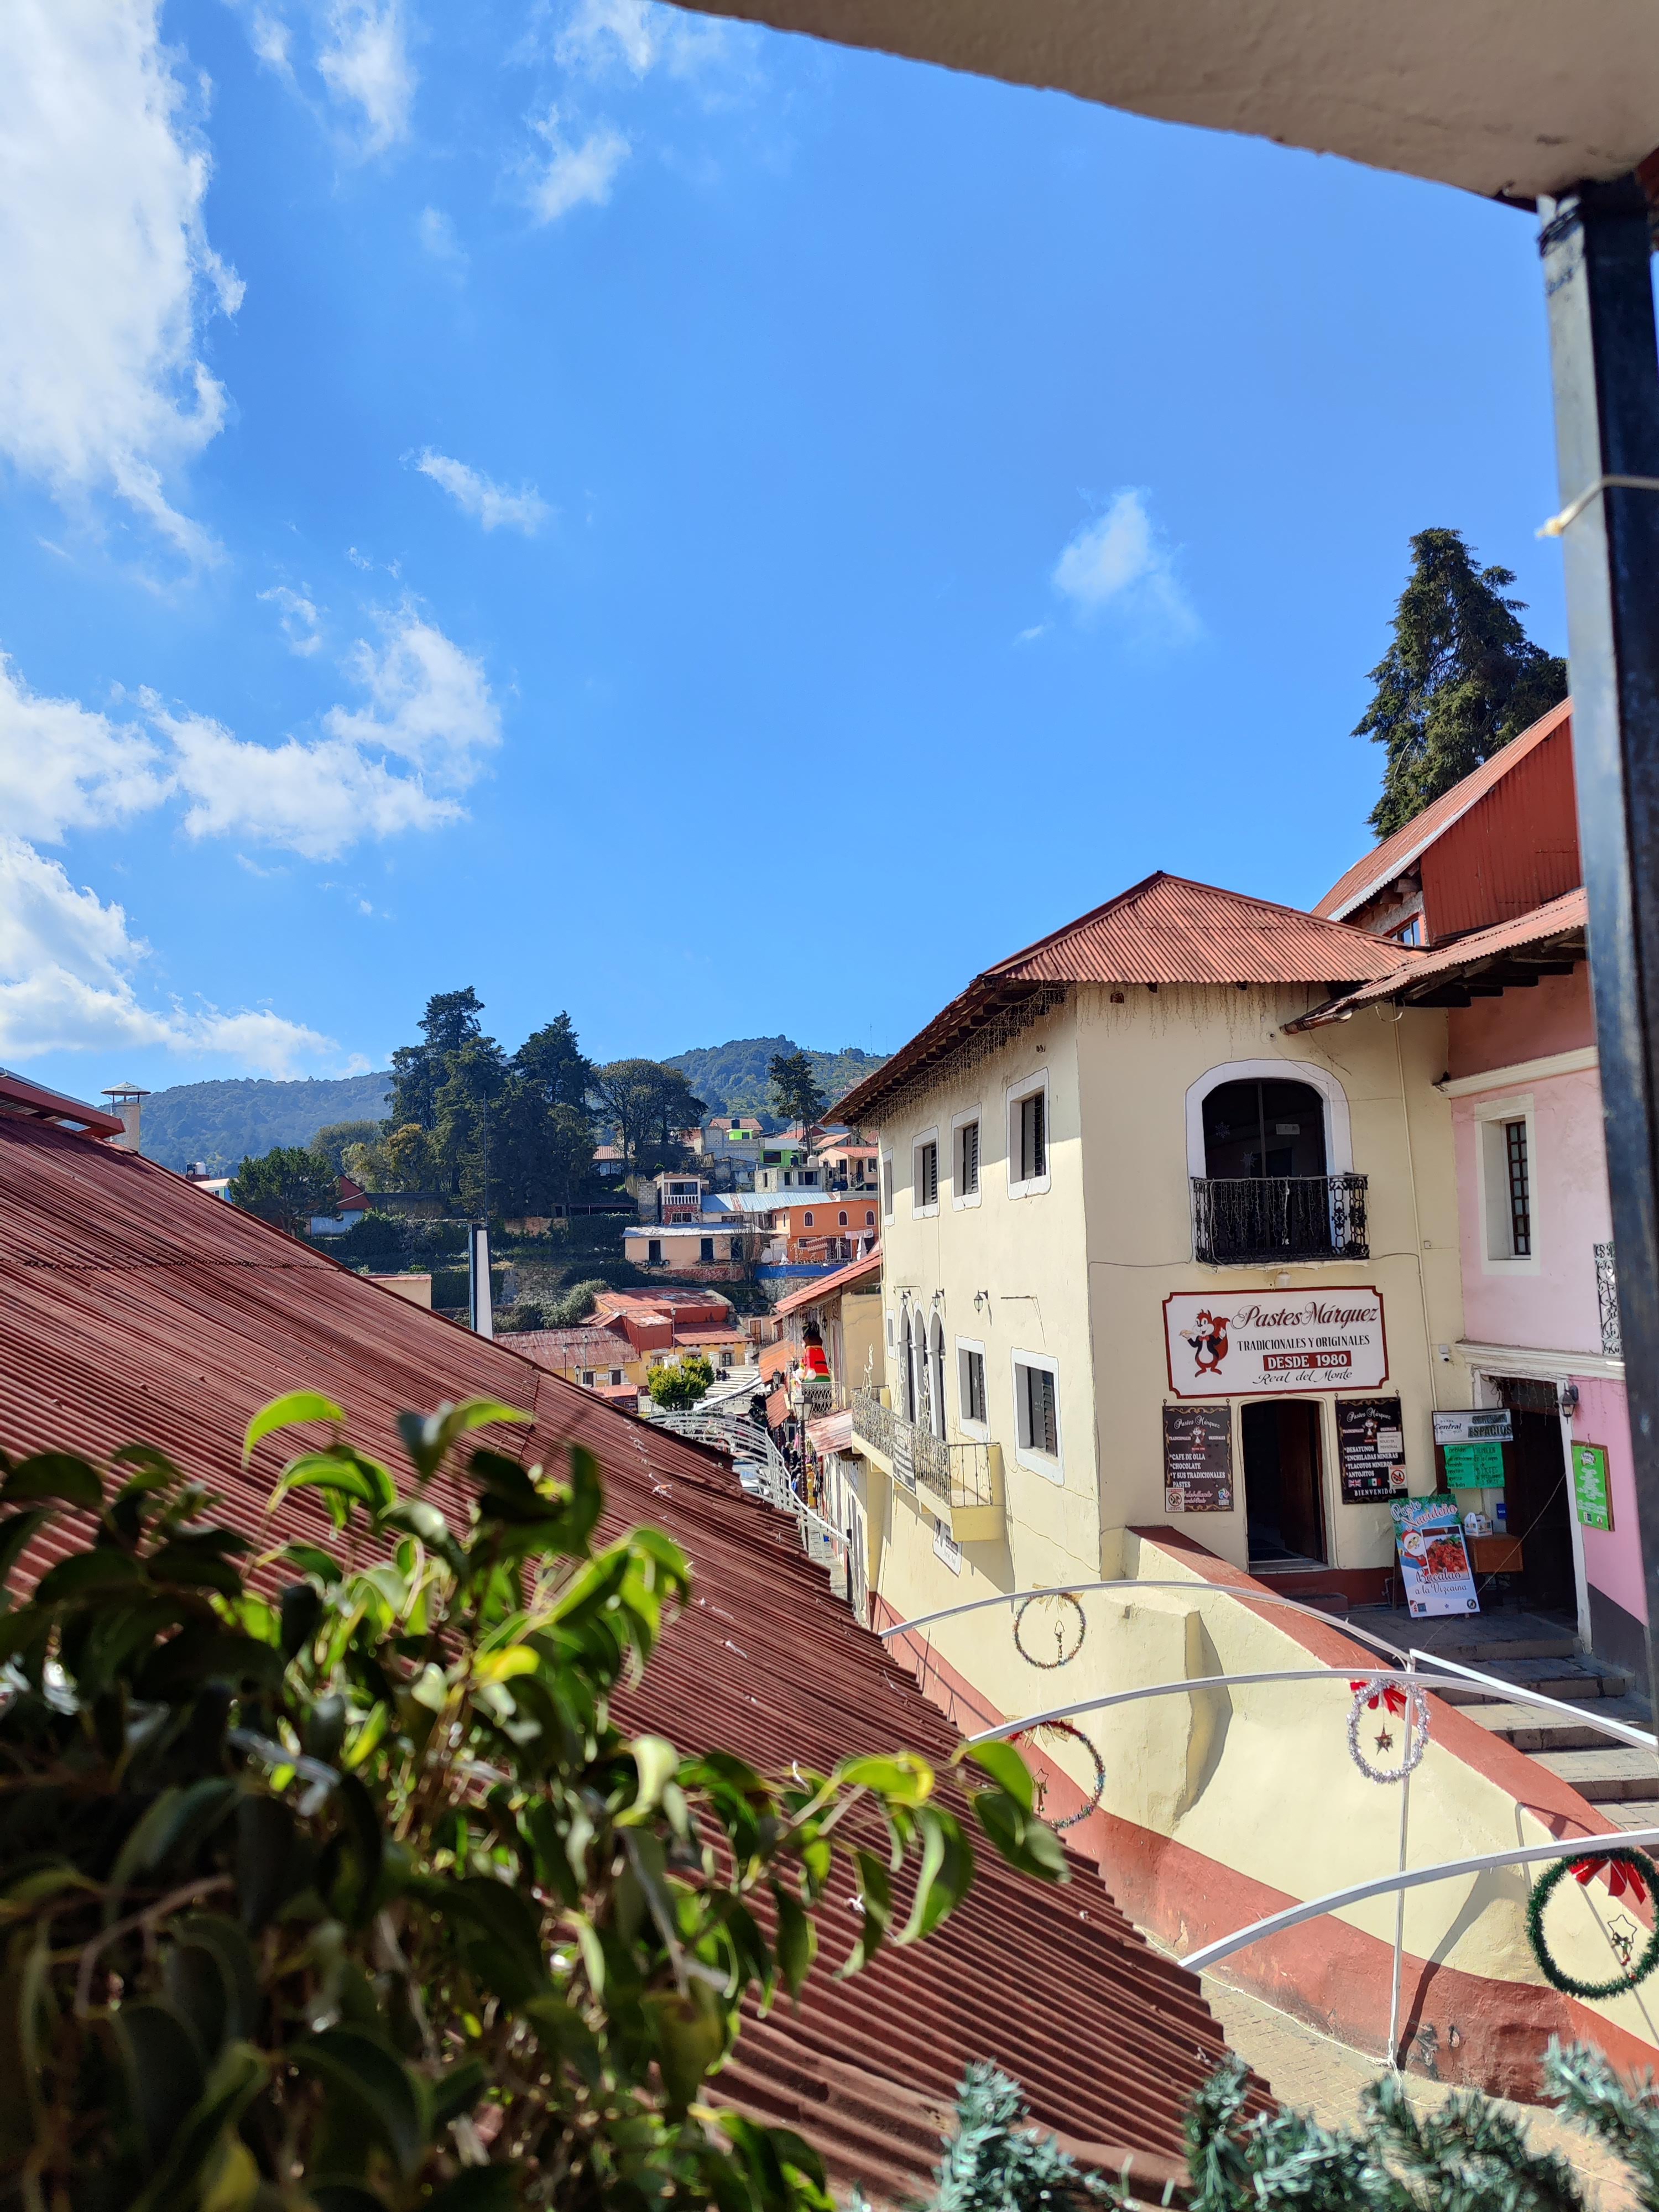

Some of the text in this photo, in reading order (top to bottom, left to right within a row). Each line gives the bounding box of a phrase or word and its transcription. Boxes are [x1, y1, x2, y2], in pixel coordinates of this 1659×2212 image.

[1230, 1301, 1379, 1329] Pastes Márquez
[1237, 1335, 1370, 1351] TRADICIONALES Y ORIGINALES
[1267, 1354, 1347, 1369] DESDE 1980
[1253, 1368, 1352, 1385] Real del Monte
[1174, 1418, 1194, 1429] Pastes
[1347, 1411, 1366, 1422] Pastes
[1468, 1424, 1512, 1438] ESPACIOS
[1390, 1500, 1422, 1521] Paste
[1402, 1504, 1458, 1532] Navideño
[1416, 1568, 1461, 1584] Bacalao
[1422, 1586, 1430, 1594] la
